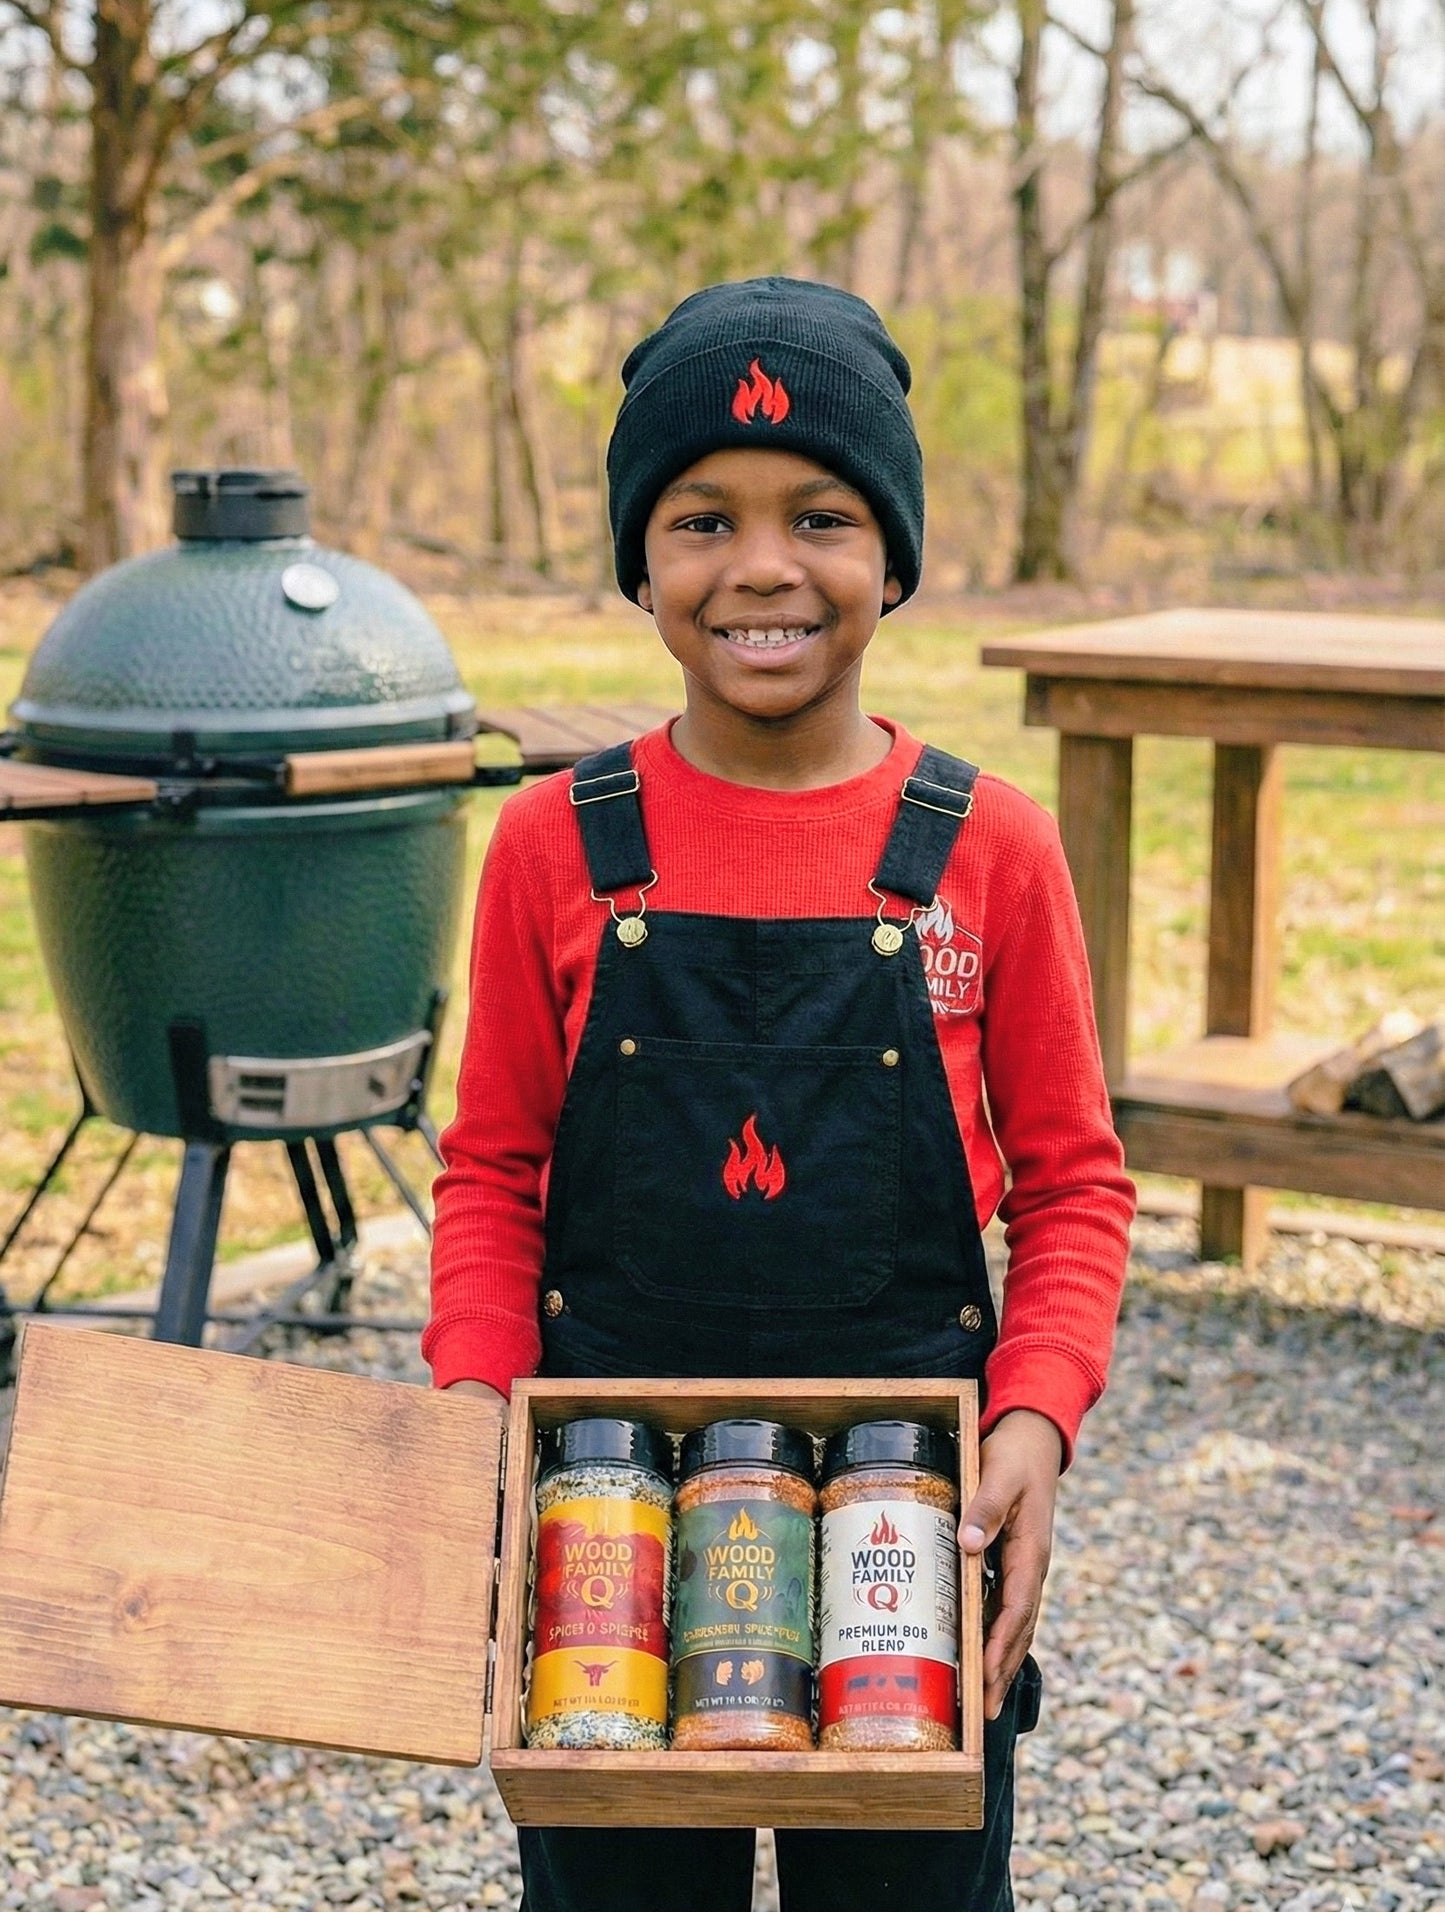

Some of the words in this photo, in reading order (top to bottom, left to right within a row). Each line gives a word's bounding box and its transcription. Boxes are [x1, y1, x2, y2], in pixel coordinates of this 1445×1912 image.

[920, 945, 979, 978] OOD
[926, 977, 970, 999] MILY
[565, 1541, 633, 1562] WOOD
[707, 1545, 775, 1566] WOOD
[851, 1549, 916, 1569] WOOD
[565, 1561, 633, 1578] FAMILY
[708, 1565, 775, 1581] FAMILY
[852, 1569, 915, 1584] FAMILY
[581, 1575, 615, 1609] Q
[726, 1580, 758, 1612] Q
[867, 1583, 899, 1613] Q
[838, 1624, 897, 1641] PREMIUM
